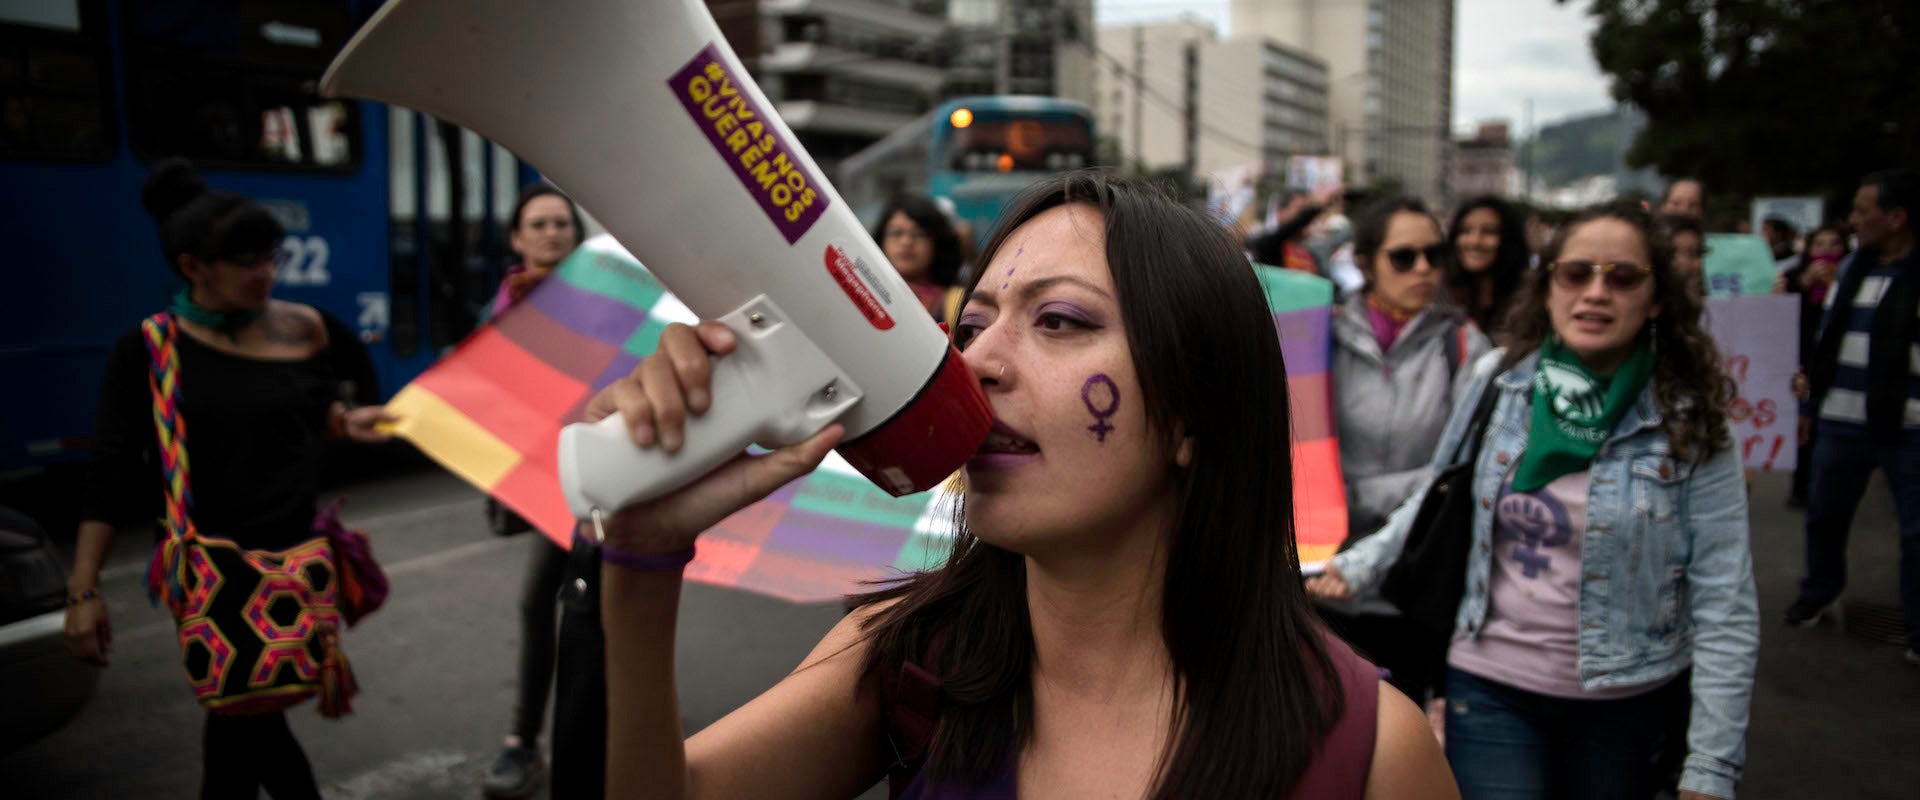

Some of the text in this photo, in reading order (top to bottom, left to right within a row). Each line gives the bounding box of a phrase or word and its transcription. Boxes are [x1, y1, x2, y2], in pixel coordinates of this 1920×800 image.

[688, 76, 805, 222] QUEREMOS
[704, 62, 816, 207] #VIVAS NOS
[834, 258, 886, 319] Megaphone
[1728, 398, 1777, 430] os
[1743, 434, 1785, 471] r!
